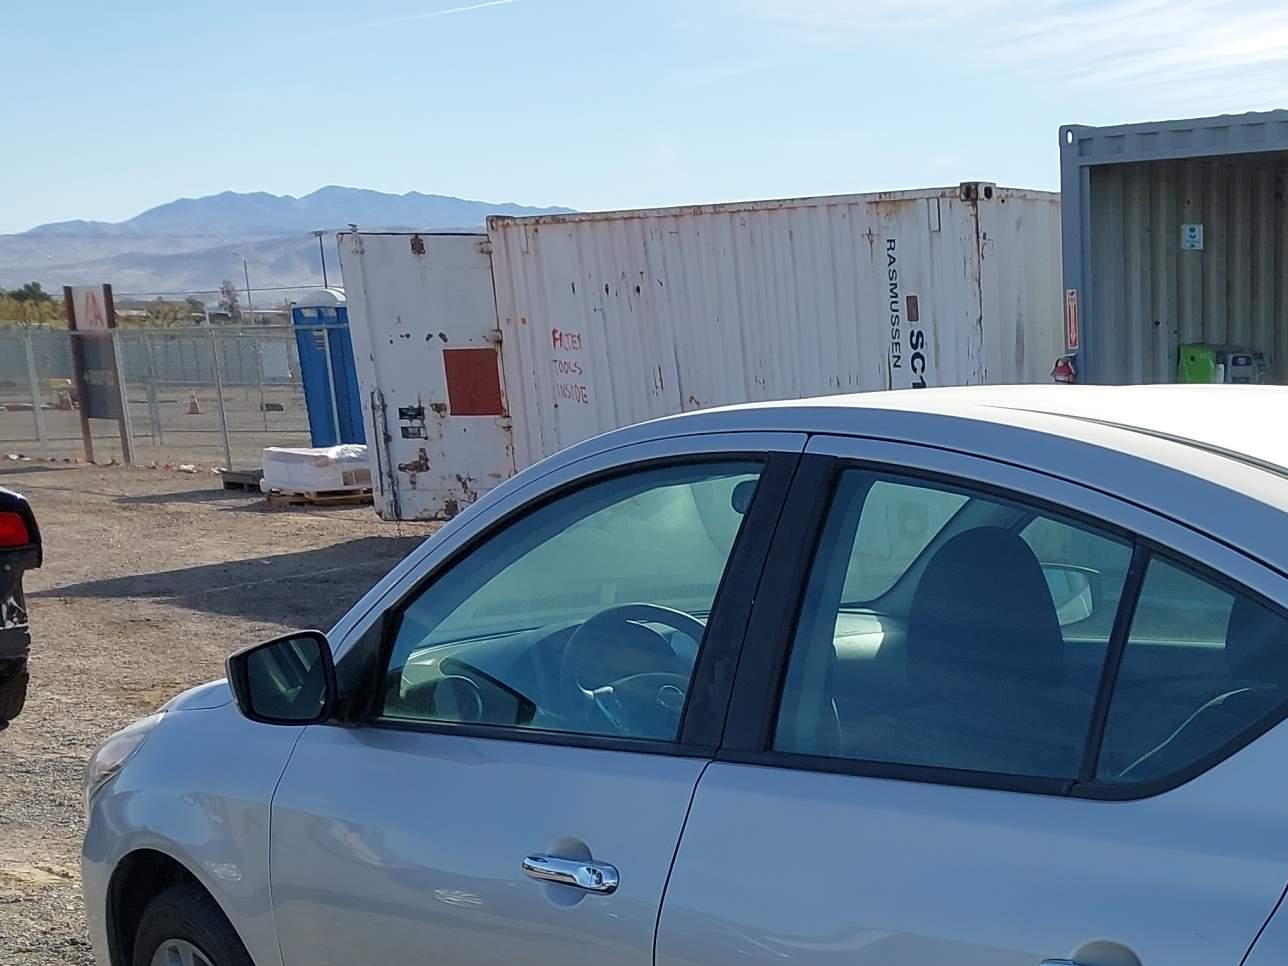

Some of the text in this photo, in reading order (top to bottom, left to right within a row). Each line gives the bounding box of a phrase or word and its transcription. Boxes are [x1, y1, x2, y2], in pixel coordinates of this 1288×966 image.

[886, 238, 901, 368] RASMUSSEN
[552, 359, 583, 376] TOOLS
[557, 382, 589, 404] INSIDE
